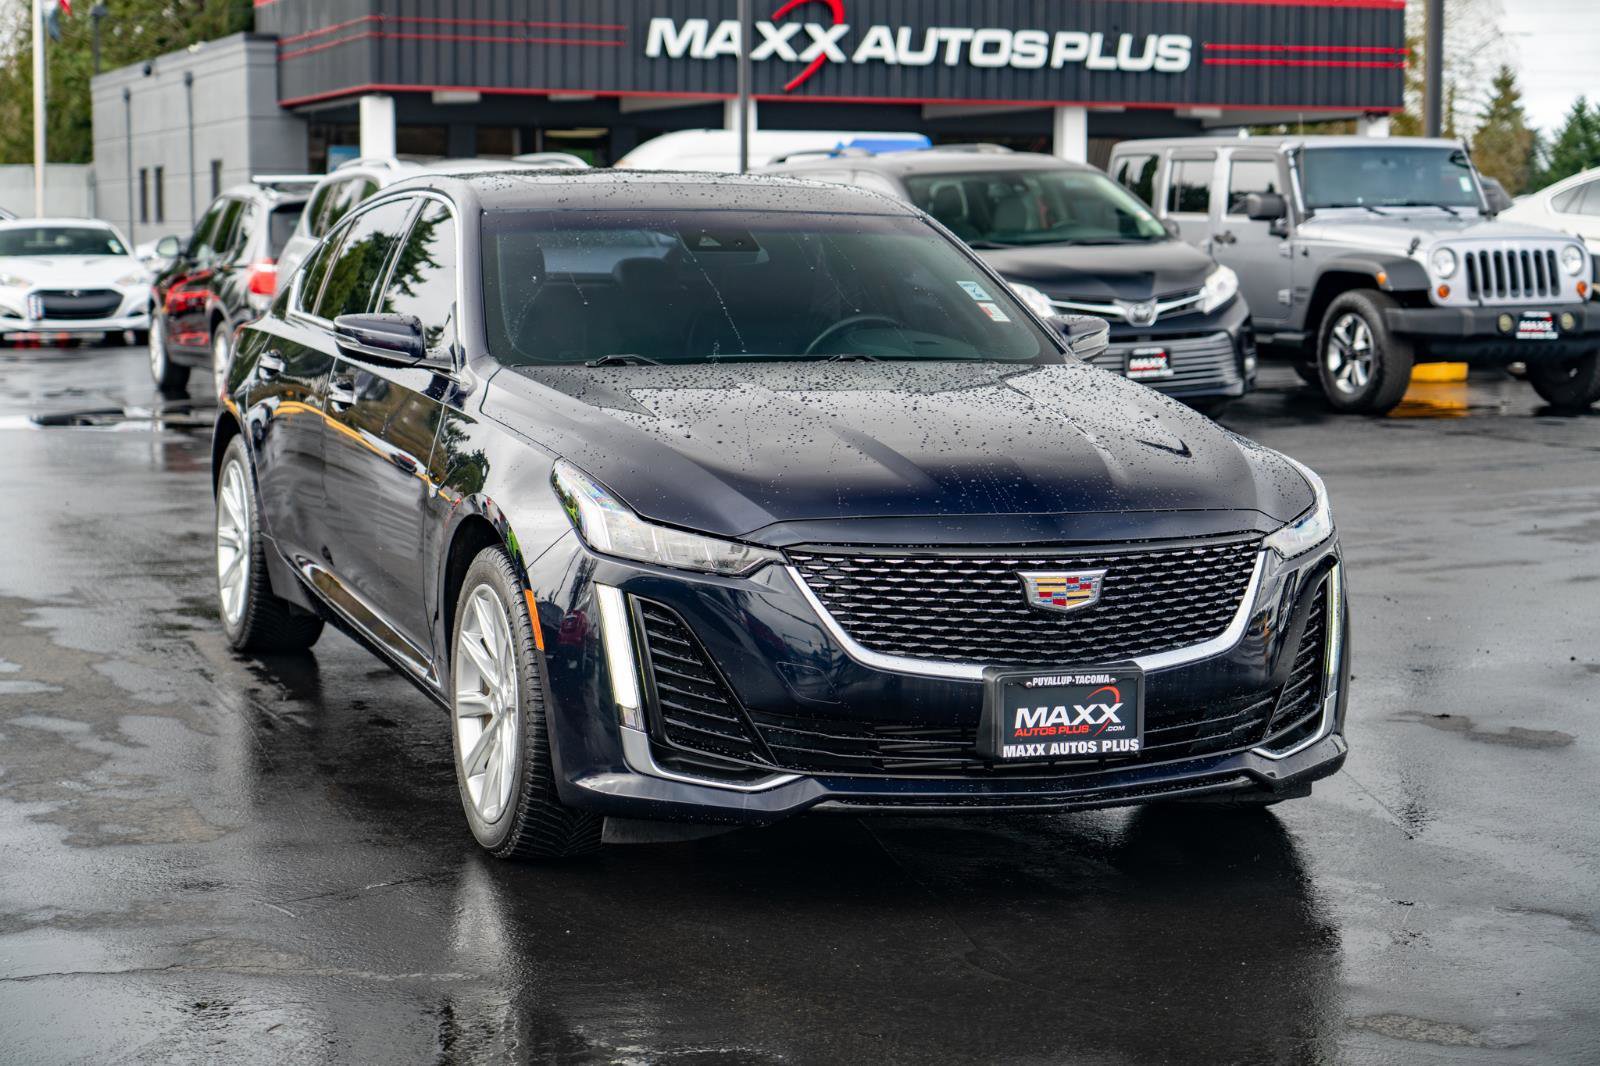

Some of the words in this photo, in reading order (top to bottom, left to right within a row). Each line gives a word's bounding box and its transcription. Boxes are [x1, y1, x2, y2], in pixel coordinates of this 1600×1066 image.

[645, 17, 850, 63] MAXX
[1014, 702, 1124, 729] MAXX
[1014, 726, 1057, 737] AUTOS
[1058, 725, 1090, 734] PLUS
[1003, 743, 1046, 758] MAXX
[1049, 741, 1098, 755] AUTOS
[1101, 738, 1140, 752] PLUS
